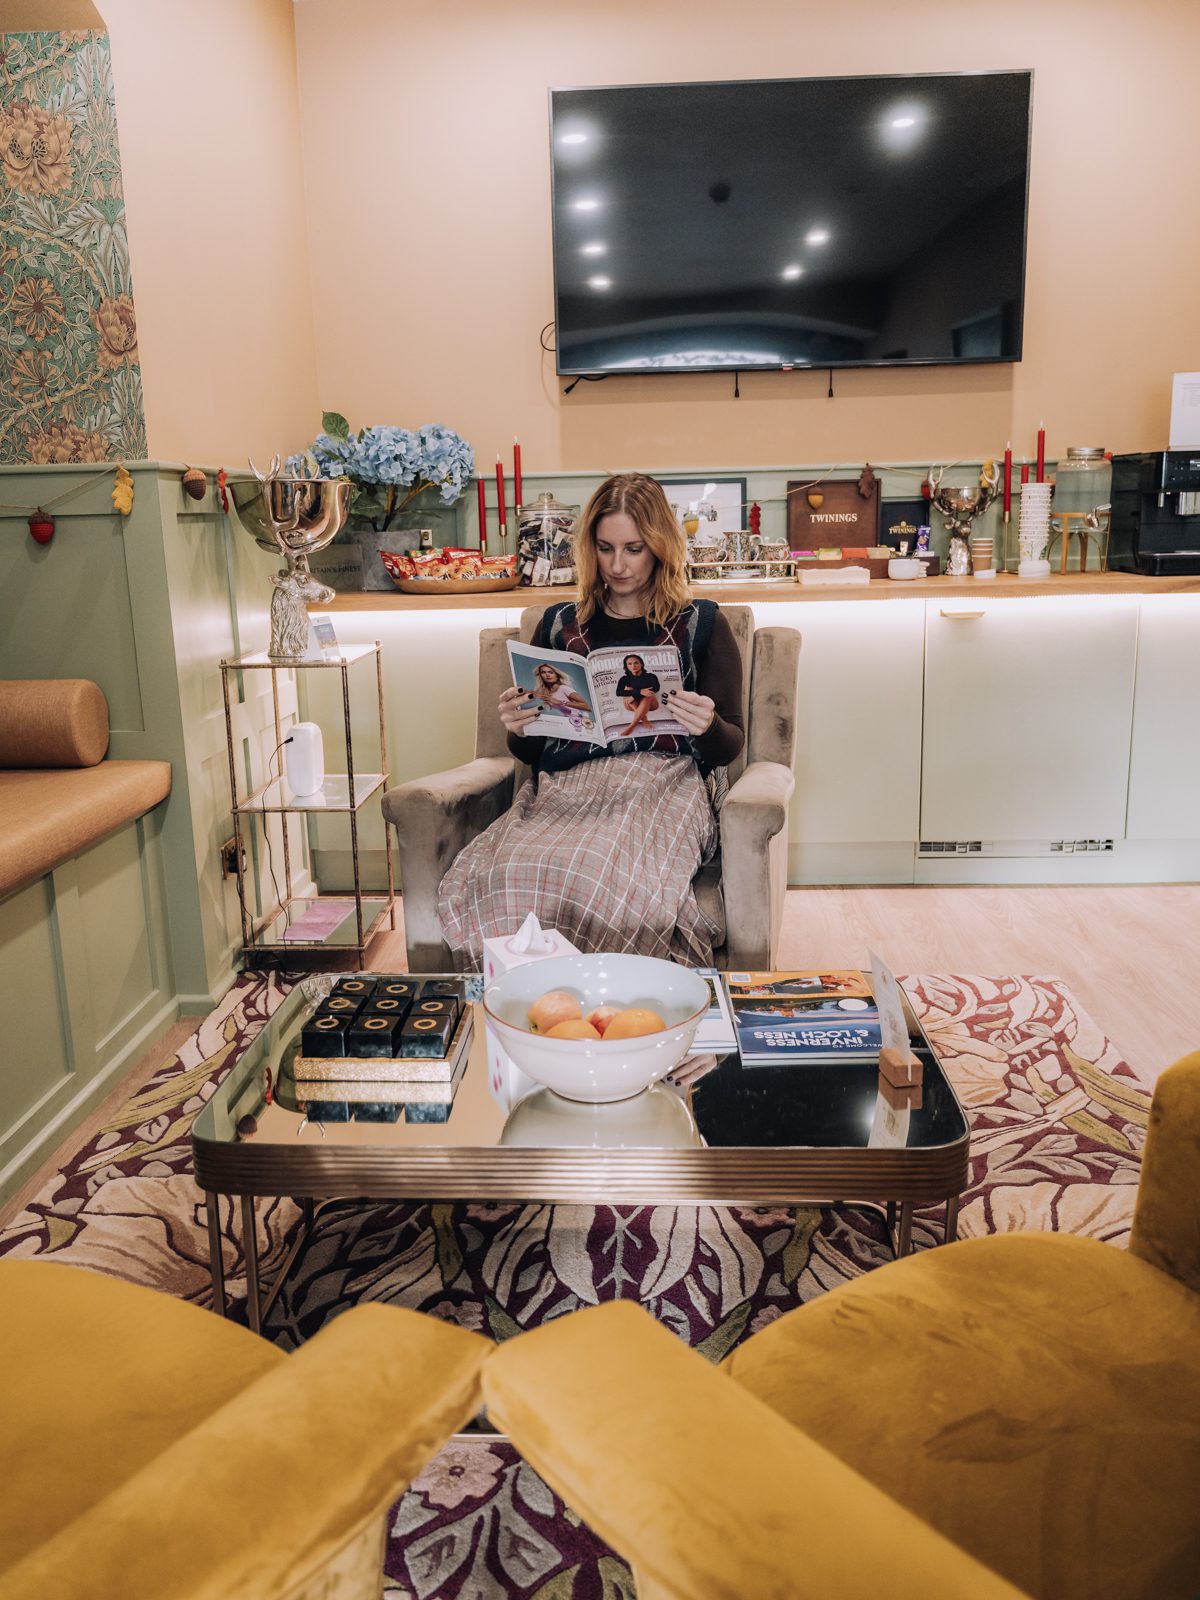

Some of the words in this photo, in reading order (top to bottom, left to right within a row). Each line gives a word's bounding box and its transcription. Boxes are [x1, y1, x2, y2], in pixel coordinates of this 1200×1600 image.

[810, 513, 858, 523] TWININGS
[753, 1031, 796, 1039] NESS
[801, 1029, 850, 1038] LOCH
[855, 1029, 869, 1037] &
[766, 1036, 863, 1047] INVERNESS
